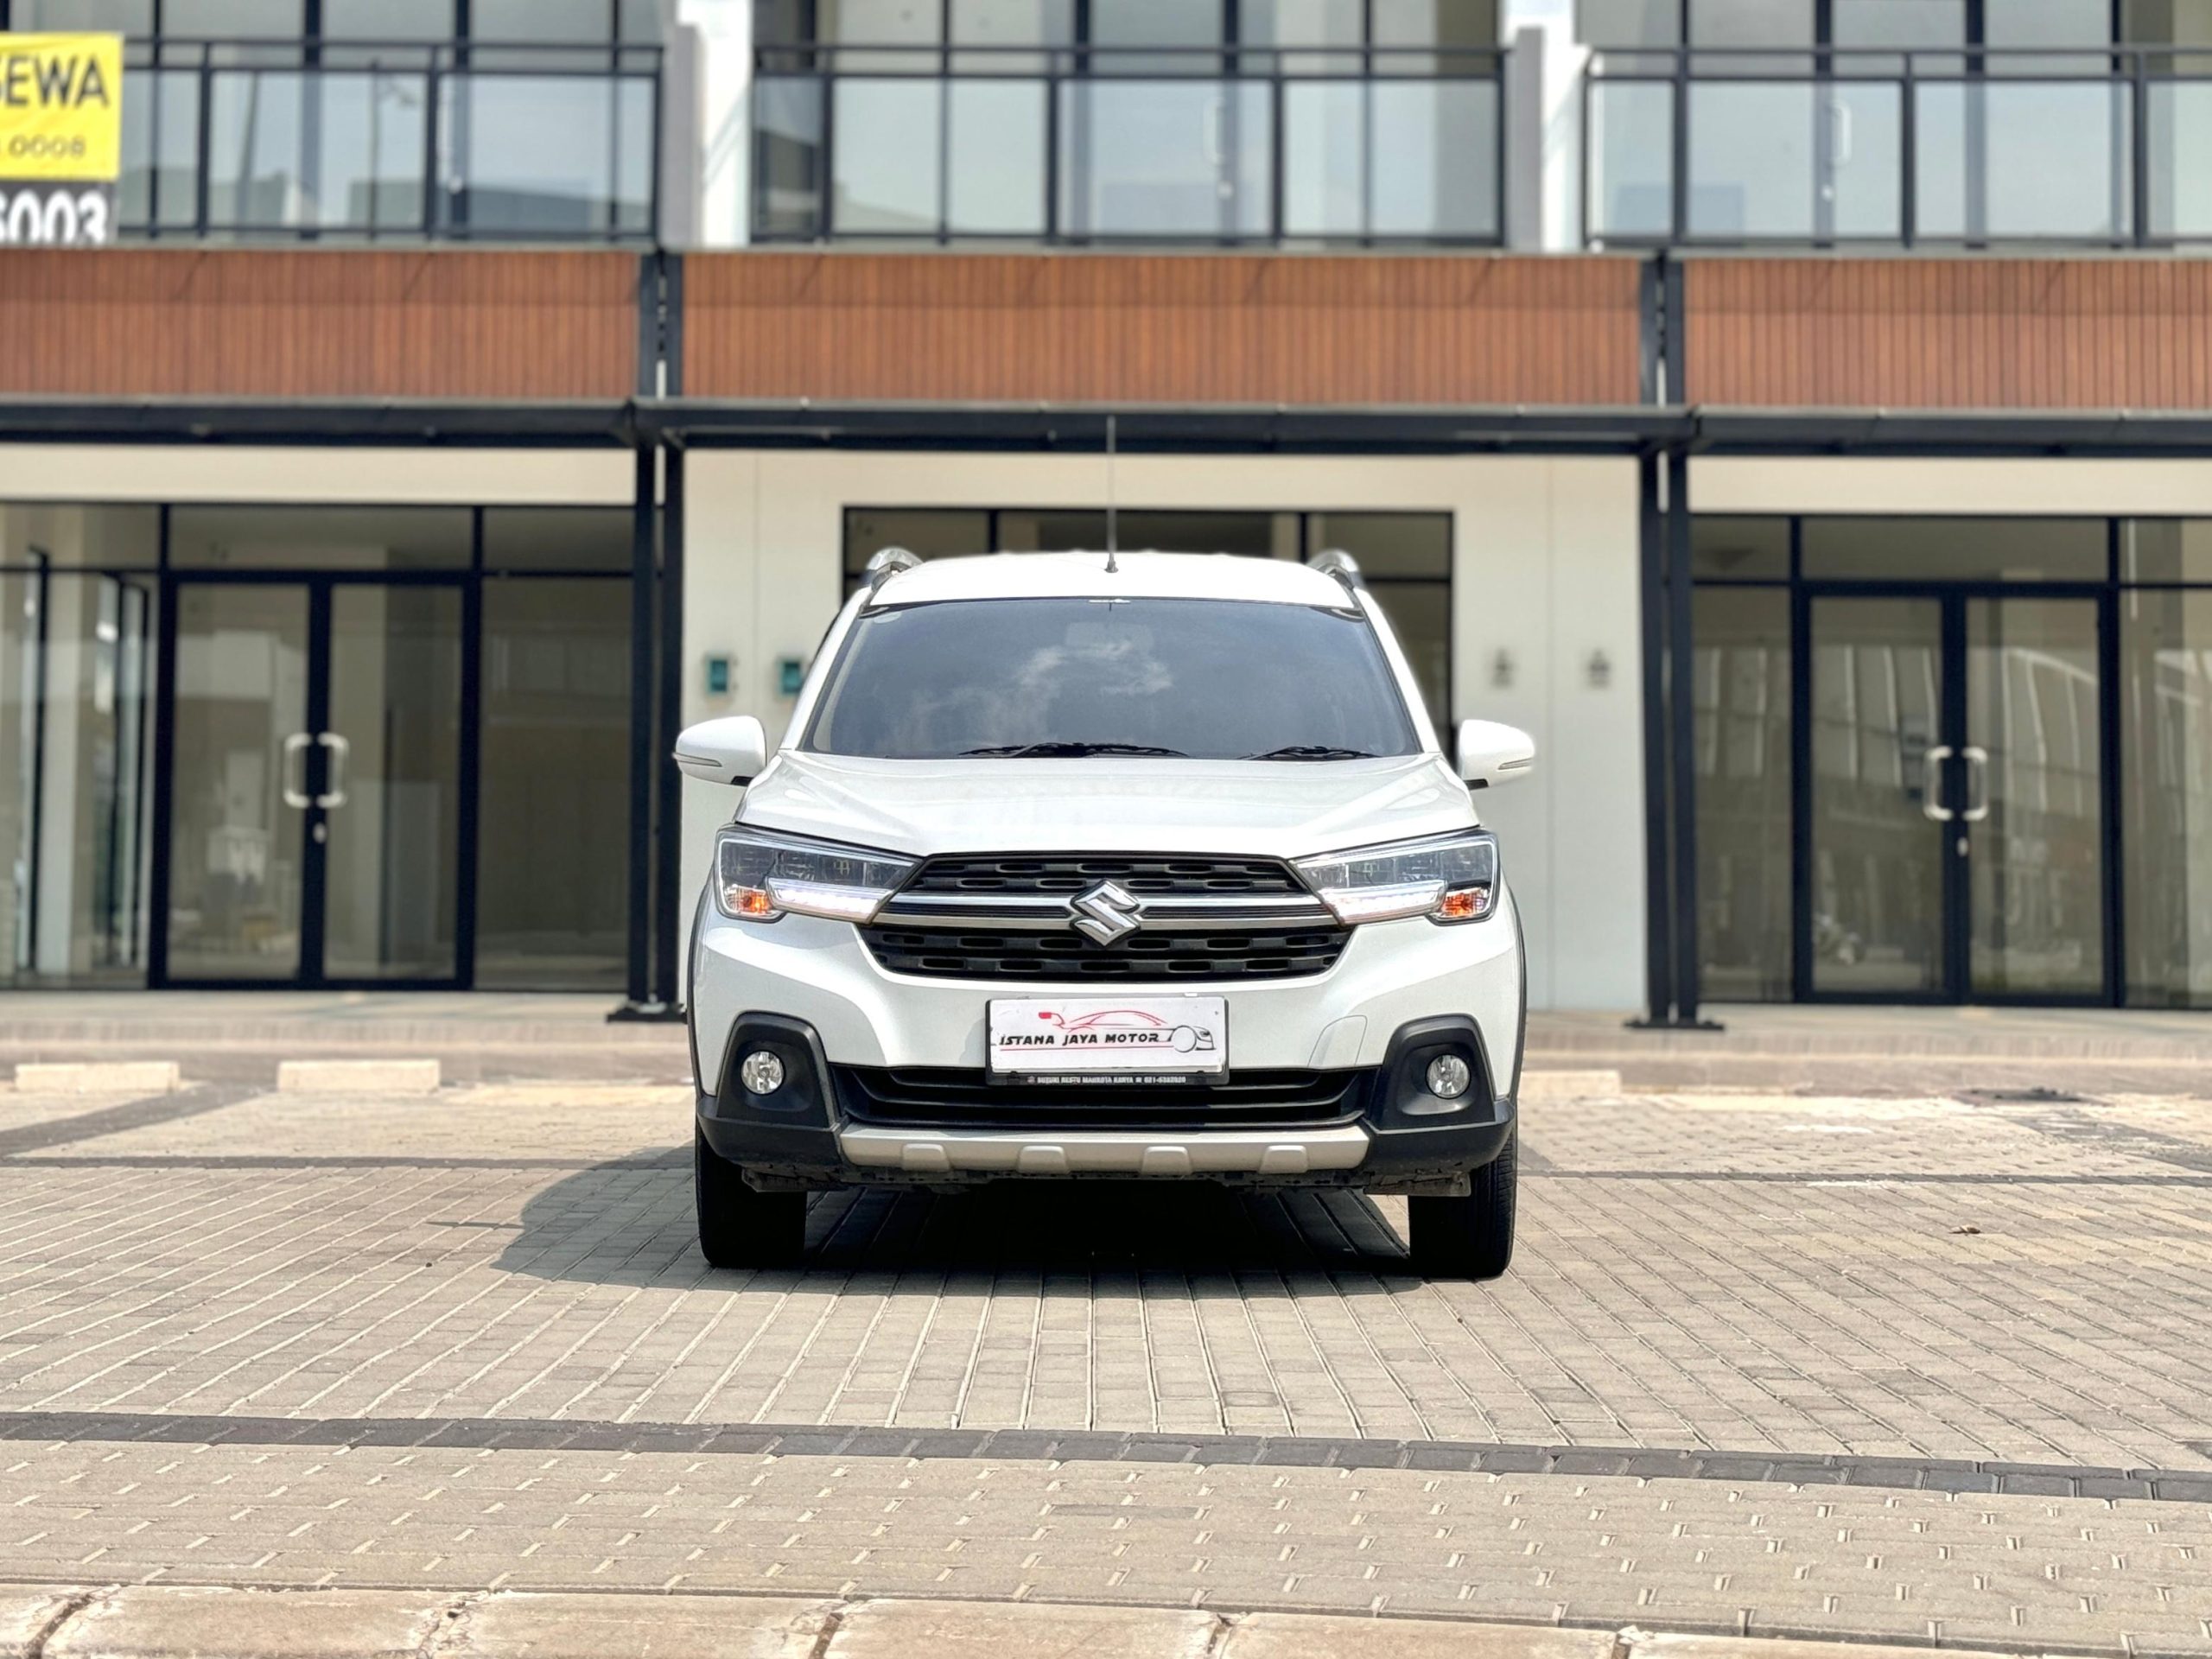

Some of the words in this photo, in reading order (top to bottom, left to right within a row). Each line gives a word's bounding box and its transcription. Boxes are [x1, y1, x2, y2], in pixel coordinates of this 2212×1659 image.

[0, 55, 110, 109] EWA
[0, 189, 108, 245] 003
[1062, 1033, 1098, 1046] JAYA
[1104, 1033, 1160, 1044] MOTOR
